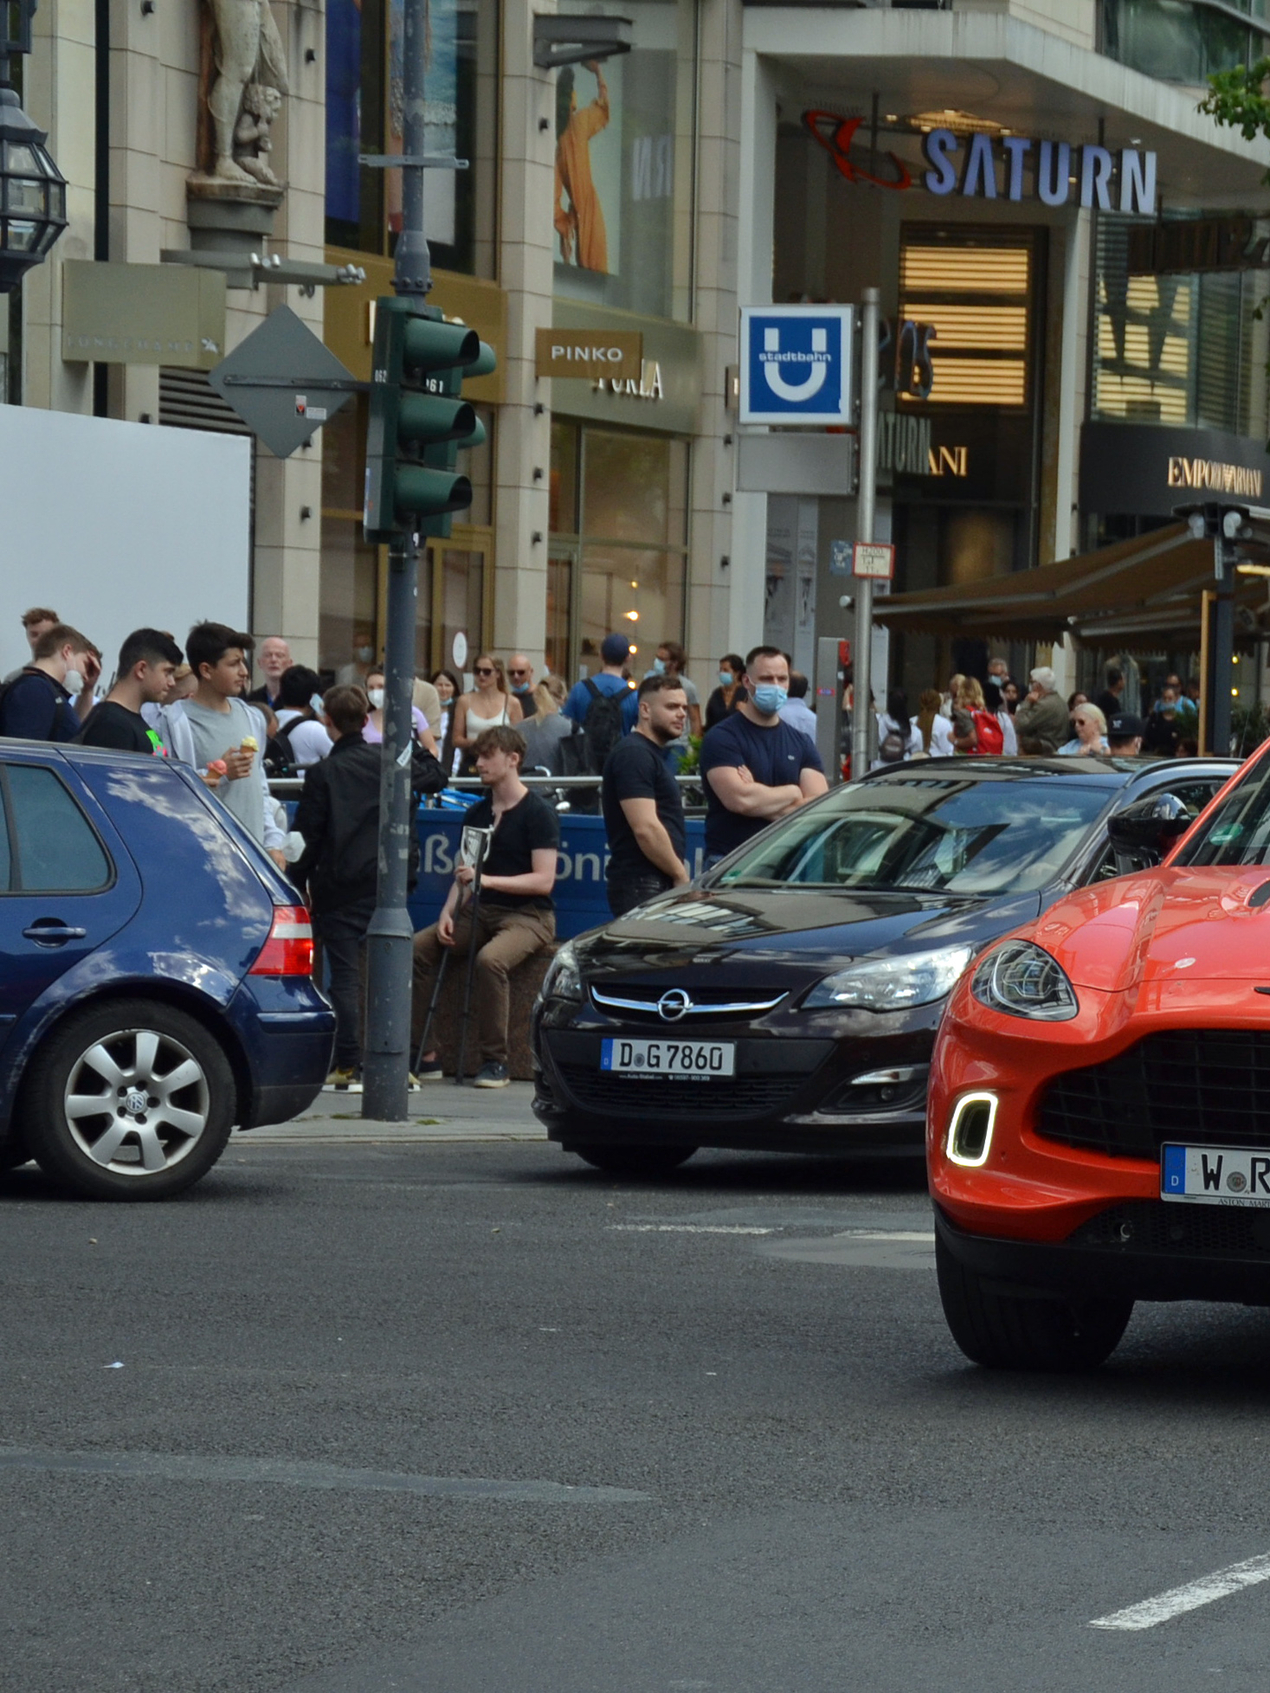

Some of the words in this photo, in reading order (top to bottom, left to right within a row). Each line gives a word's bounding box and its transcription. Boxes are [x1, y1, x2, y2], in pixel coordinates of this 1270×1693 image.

[924, 127, 1157, 215] SATURN
[551, 345, 623, 363] PINKO
[758, 351, 832, 363] stadtbahn
[620, 1043, 633, 1067] D
[647, 1044, 660, 1068] G
[666, 1045, 723, 1071] 7860
[1201, 1154, 1223, 1190] W
[1218, 1198, 1245, 1207] ASTON
